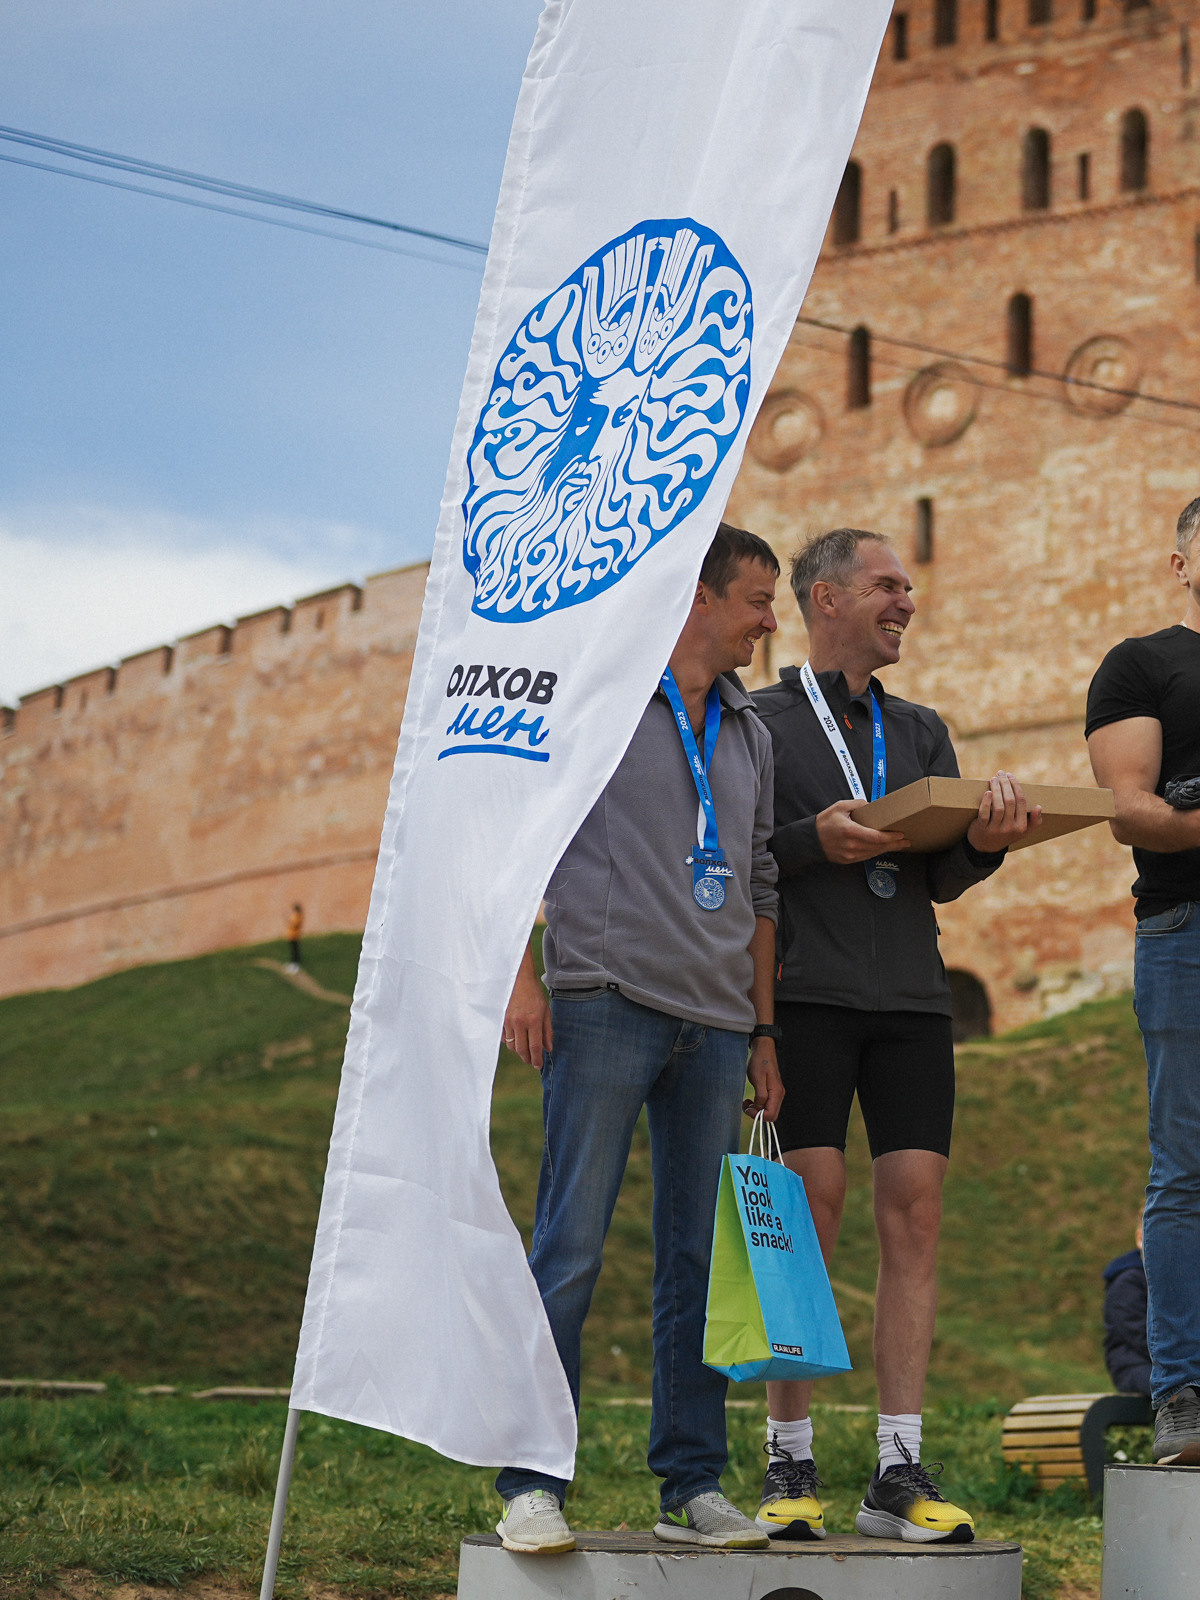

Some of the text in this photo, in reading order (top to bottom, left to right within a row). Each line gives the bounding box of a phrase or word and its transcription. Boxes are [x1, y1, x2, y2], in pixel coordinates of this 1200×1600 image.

[446, 702, 550, 747] мен
[677, 711, 689, 730] 2023
[823, 716, 836, 732] 2023
[736, 1165, 768, 1188] You
[741, 1186, 774, 1210] look
[745, 1206, 783, 1231] like a
[751, 1231, 794, 1254] snack!
